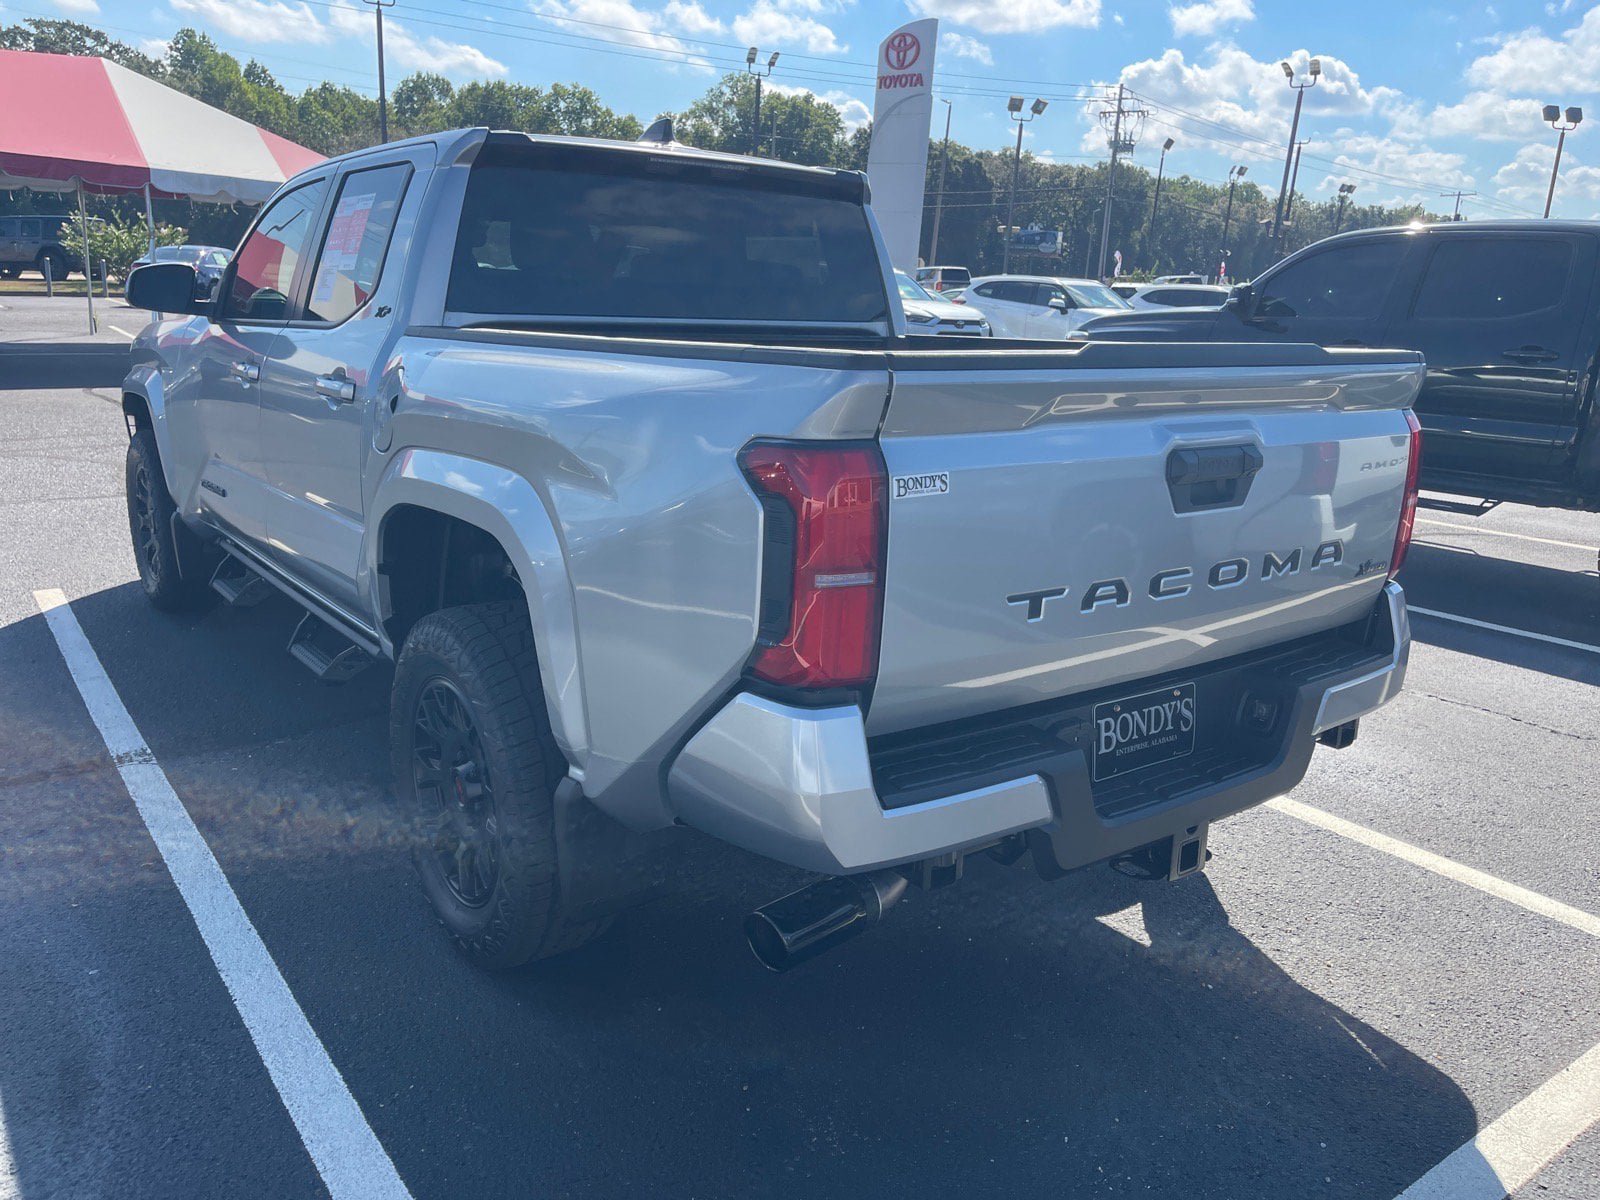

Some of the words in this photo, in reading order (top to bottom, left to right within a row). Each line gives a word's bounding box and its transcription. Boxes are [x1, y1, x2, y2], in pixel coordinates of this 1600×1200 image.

[877, 73, 924, 89] TOYOTA
[895, 473, 948, 498] BONDY'S
[1006, 538, 1344, 623] TACOMA
[1097, 698, 1193, 755] BONDY'S
